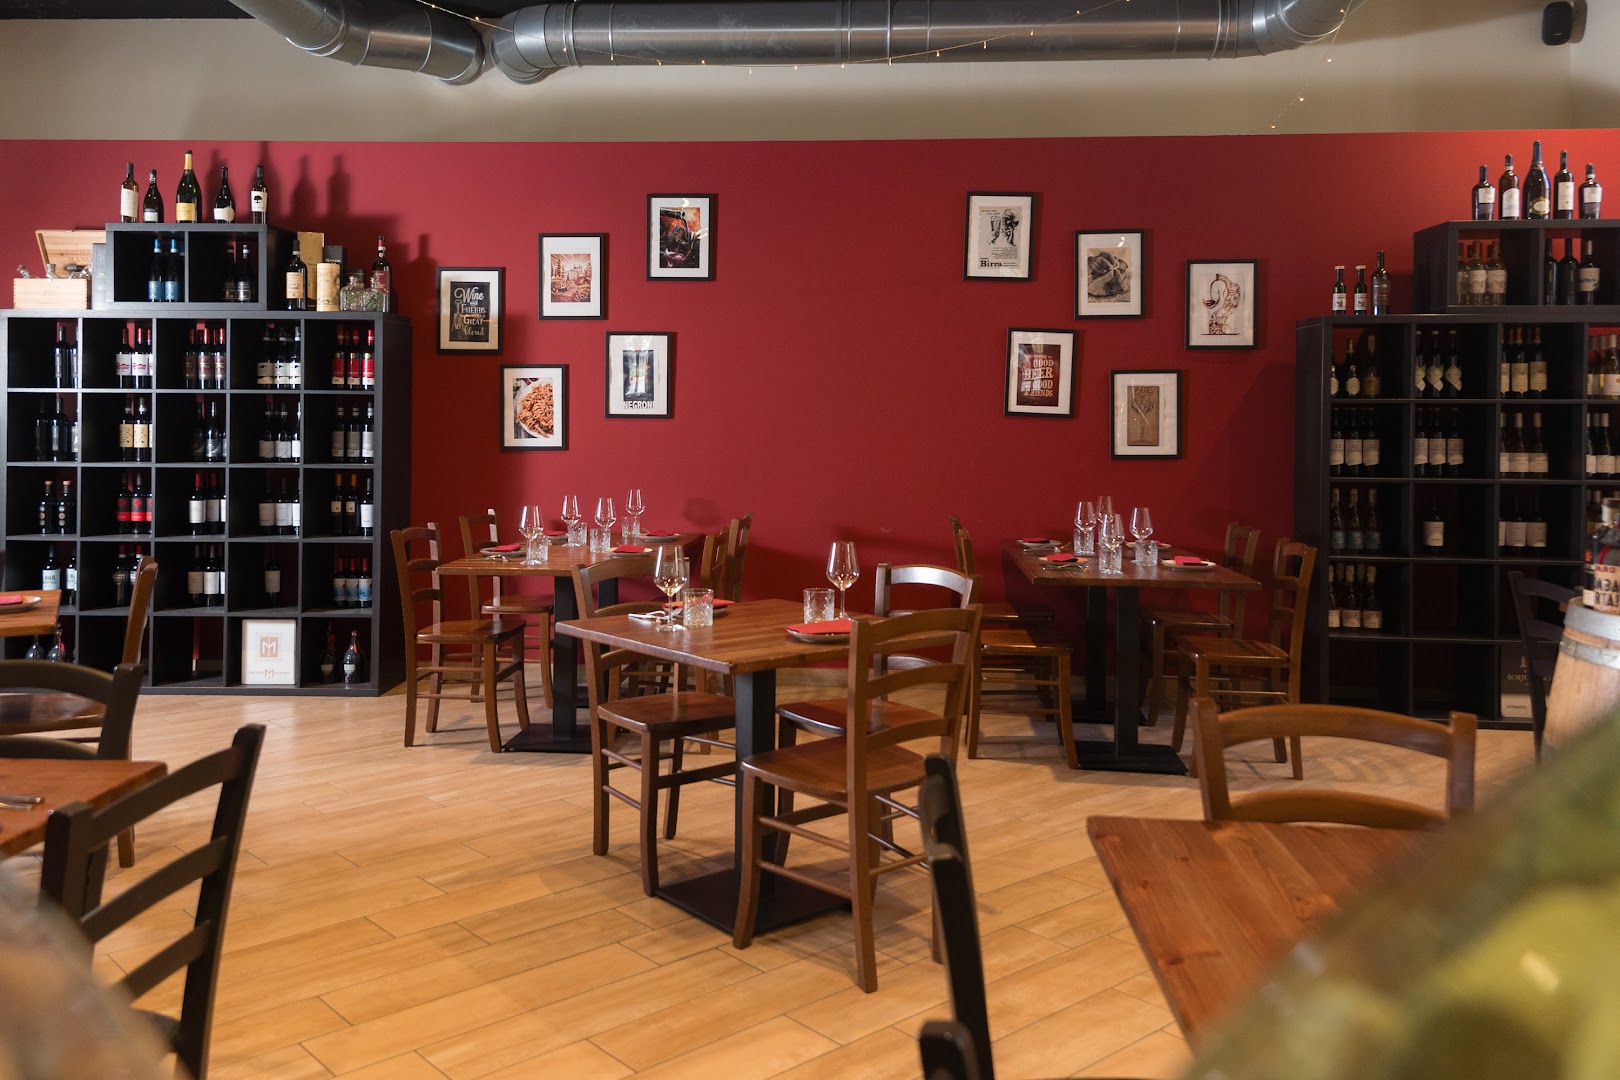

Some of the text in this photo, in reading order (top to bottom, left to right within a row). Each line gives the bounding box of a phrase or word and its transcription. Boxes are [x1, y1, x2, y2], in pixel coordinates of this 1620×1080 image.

[454, 286, 484, 303] Wine
[461, 304, 486, 314] FRIENDS
[1032, 358, 1054, 368] GOOD
[1023, 367, 1054, 381] BEER
[1032, 380, 1054, 391] GOOD
[1023, 387, 1054, 398] FRIENDS
[624, 401, 653, 410] NEGRONI
